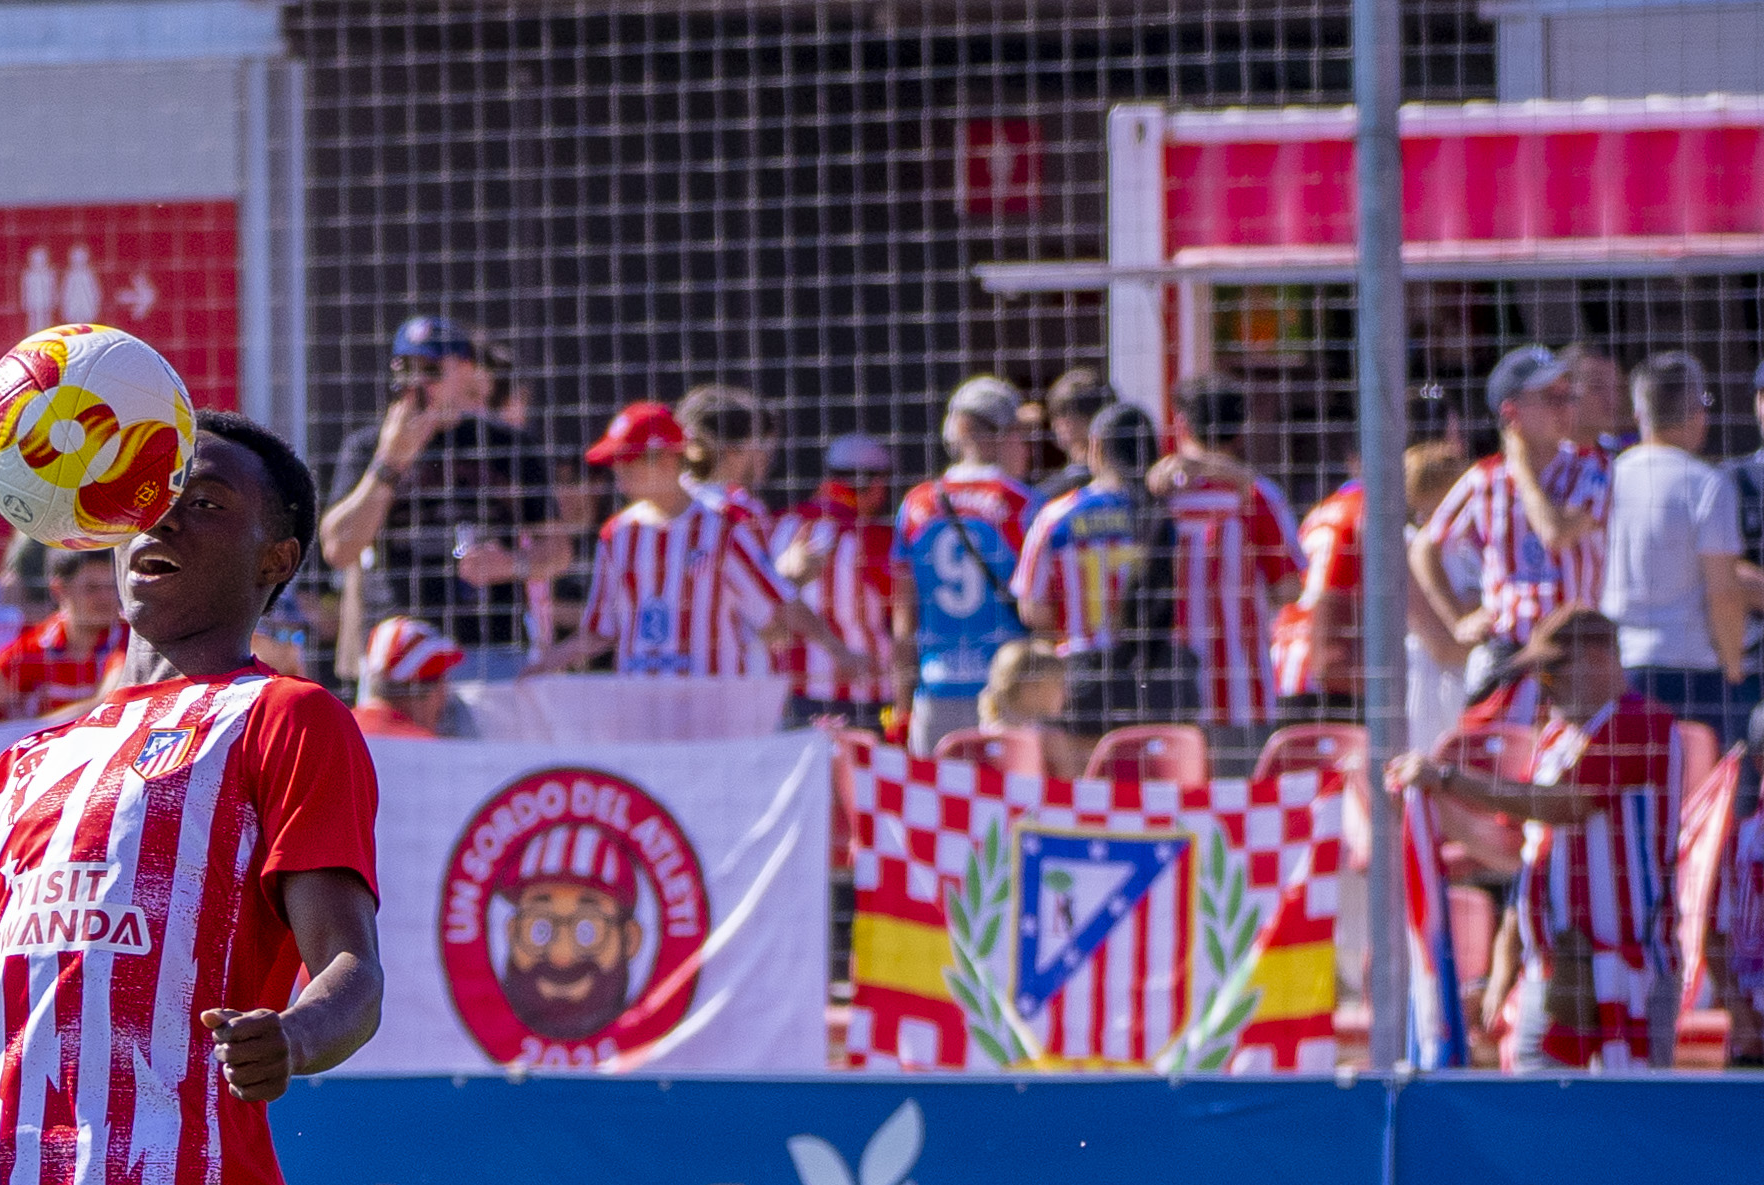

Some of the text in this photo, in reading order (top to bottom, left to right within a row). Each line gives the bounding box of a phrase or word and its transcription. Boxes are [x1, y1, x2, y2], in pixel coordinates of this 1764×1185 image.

[933, 529, 986, 620] 9
[17, 869, 108, 909] VISIT
[445, 778, 700, 944] UN SORDO DEL ATLETI
